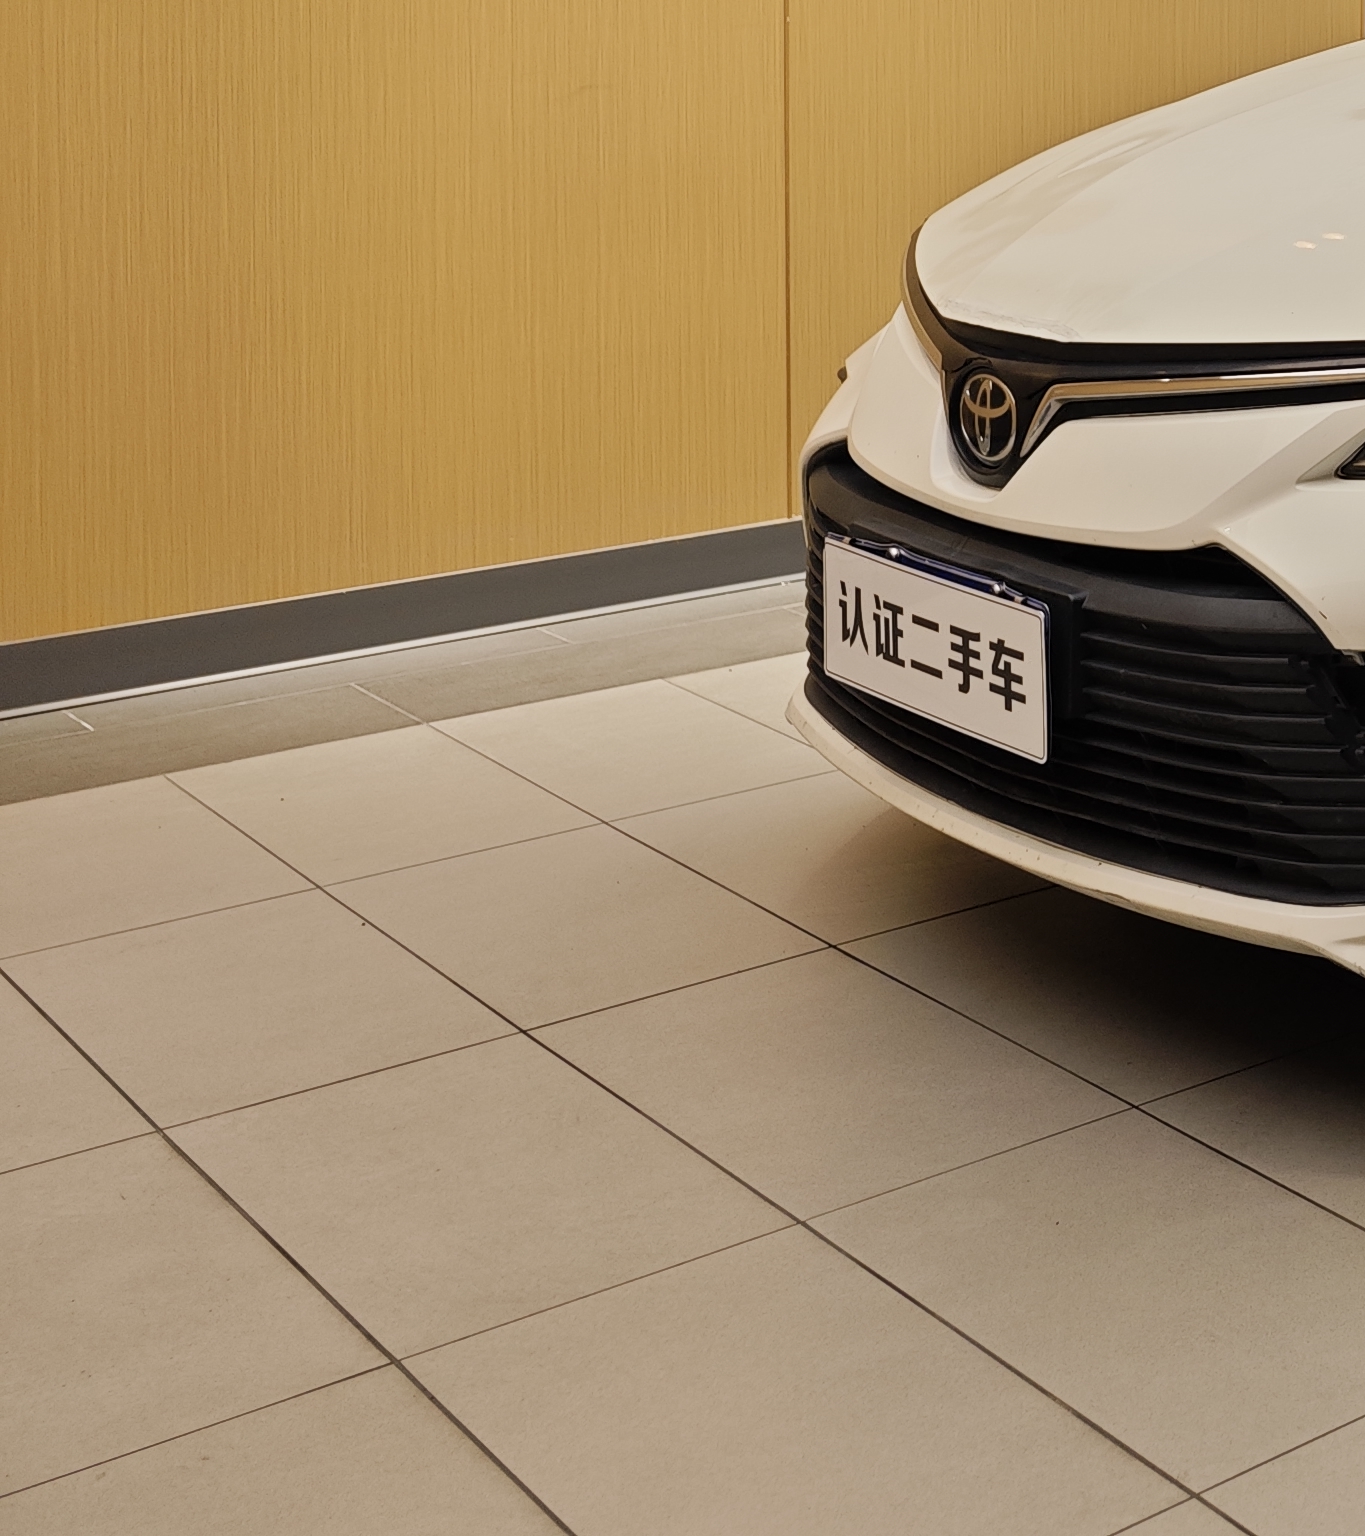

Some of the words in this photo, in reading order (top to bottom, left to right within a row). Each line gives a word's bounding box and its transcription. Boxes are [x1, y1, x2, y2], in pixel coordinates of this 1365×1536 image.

[839, 580, 1026, 712] 认证二手车
